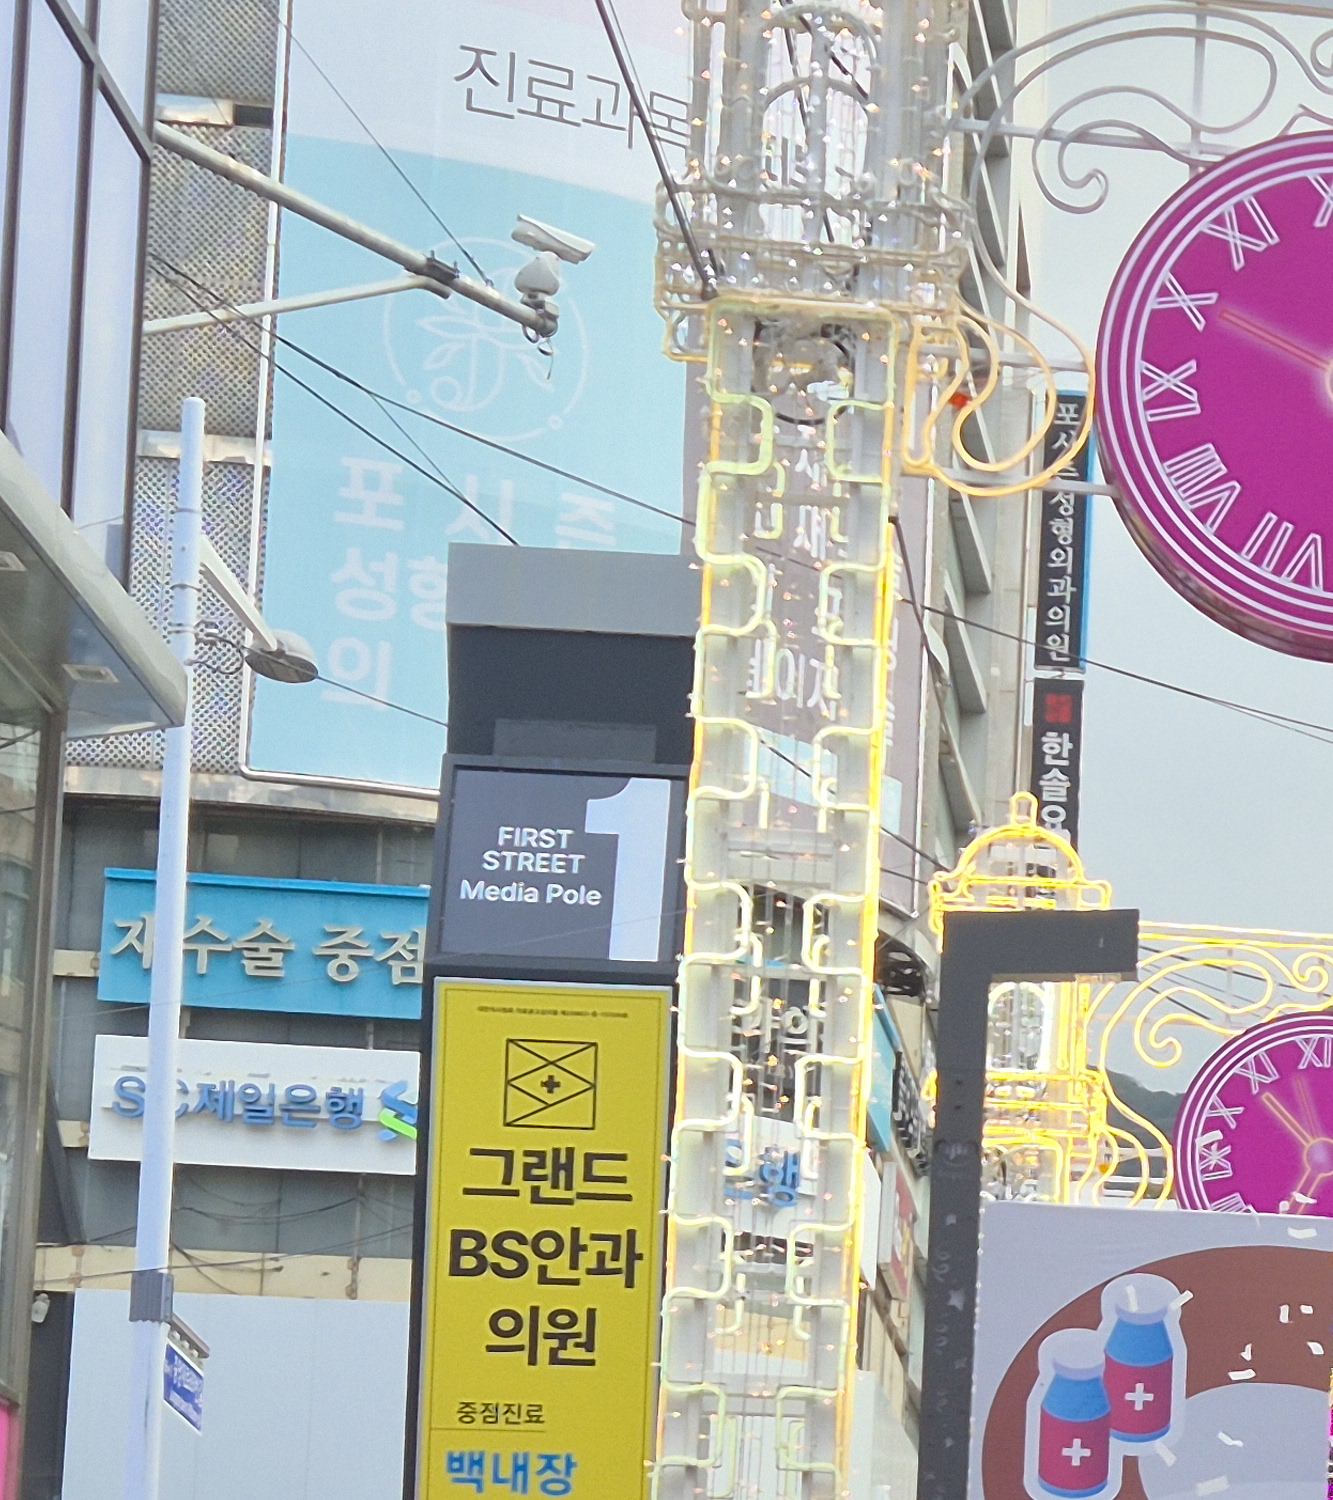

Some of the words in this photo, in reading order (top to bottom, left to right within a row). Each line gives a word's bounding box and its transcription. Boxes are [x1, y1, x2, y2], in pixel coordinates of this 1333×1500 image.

[498, 826, 575, 849] FIRST
[482, 850, 586, 874] STREET
[585, 777, 671, 962] 1
[460, 879, 539, 903] Media
[546, 883, 602, 906] Pole
[462, 1147, 633, 1206] 그랜드
[448, 1227, 644, 1289] BS안과
[485, 1305, 597, 1367] 의원
[456, 1401, 546, 1425] 중점진료
[446, 1450, 580, 1497] 백내장
